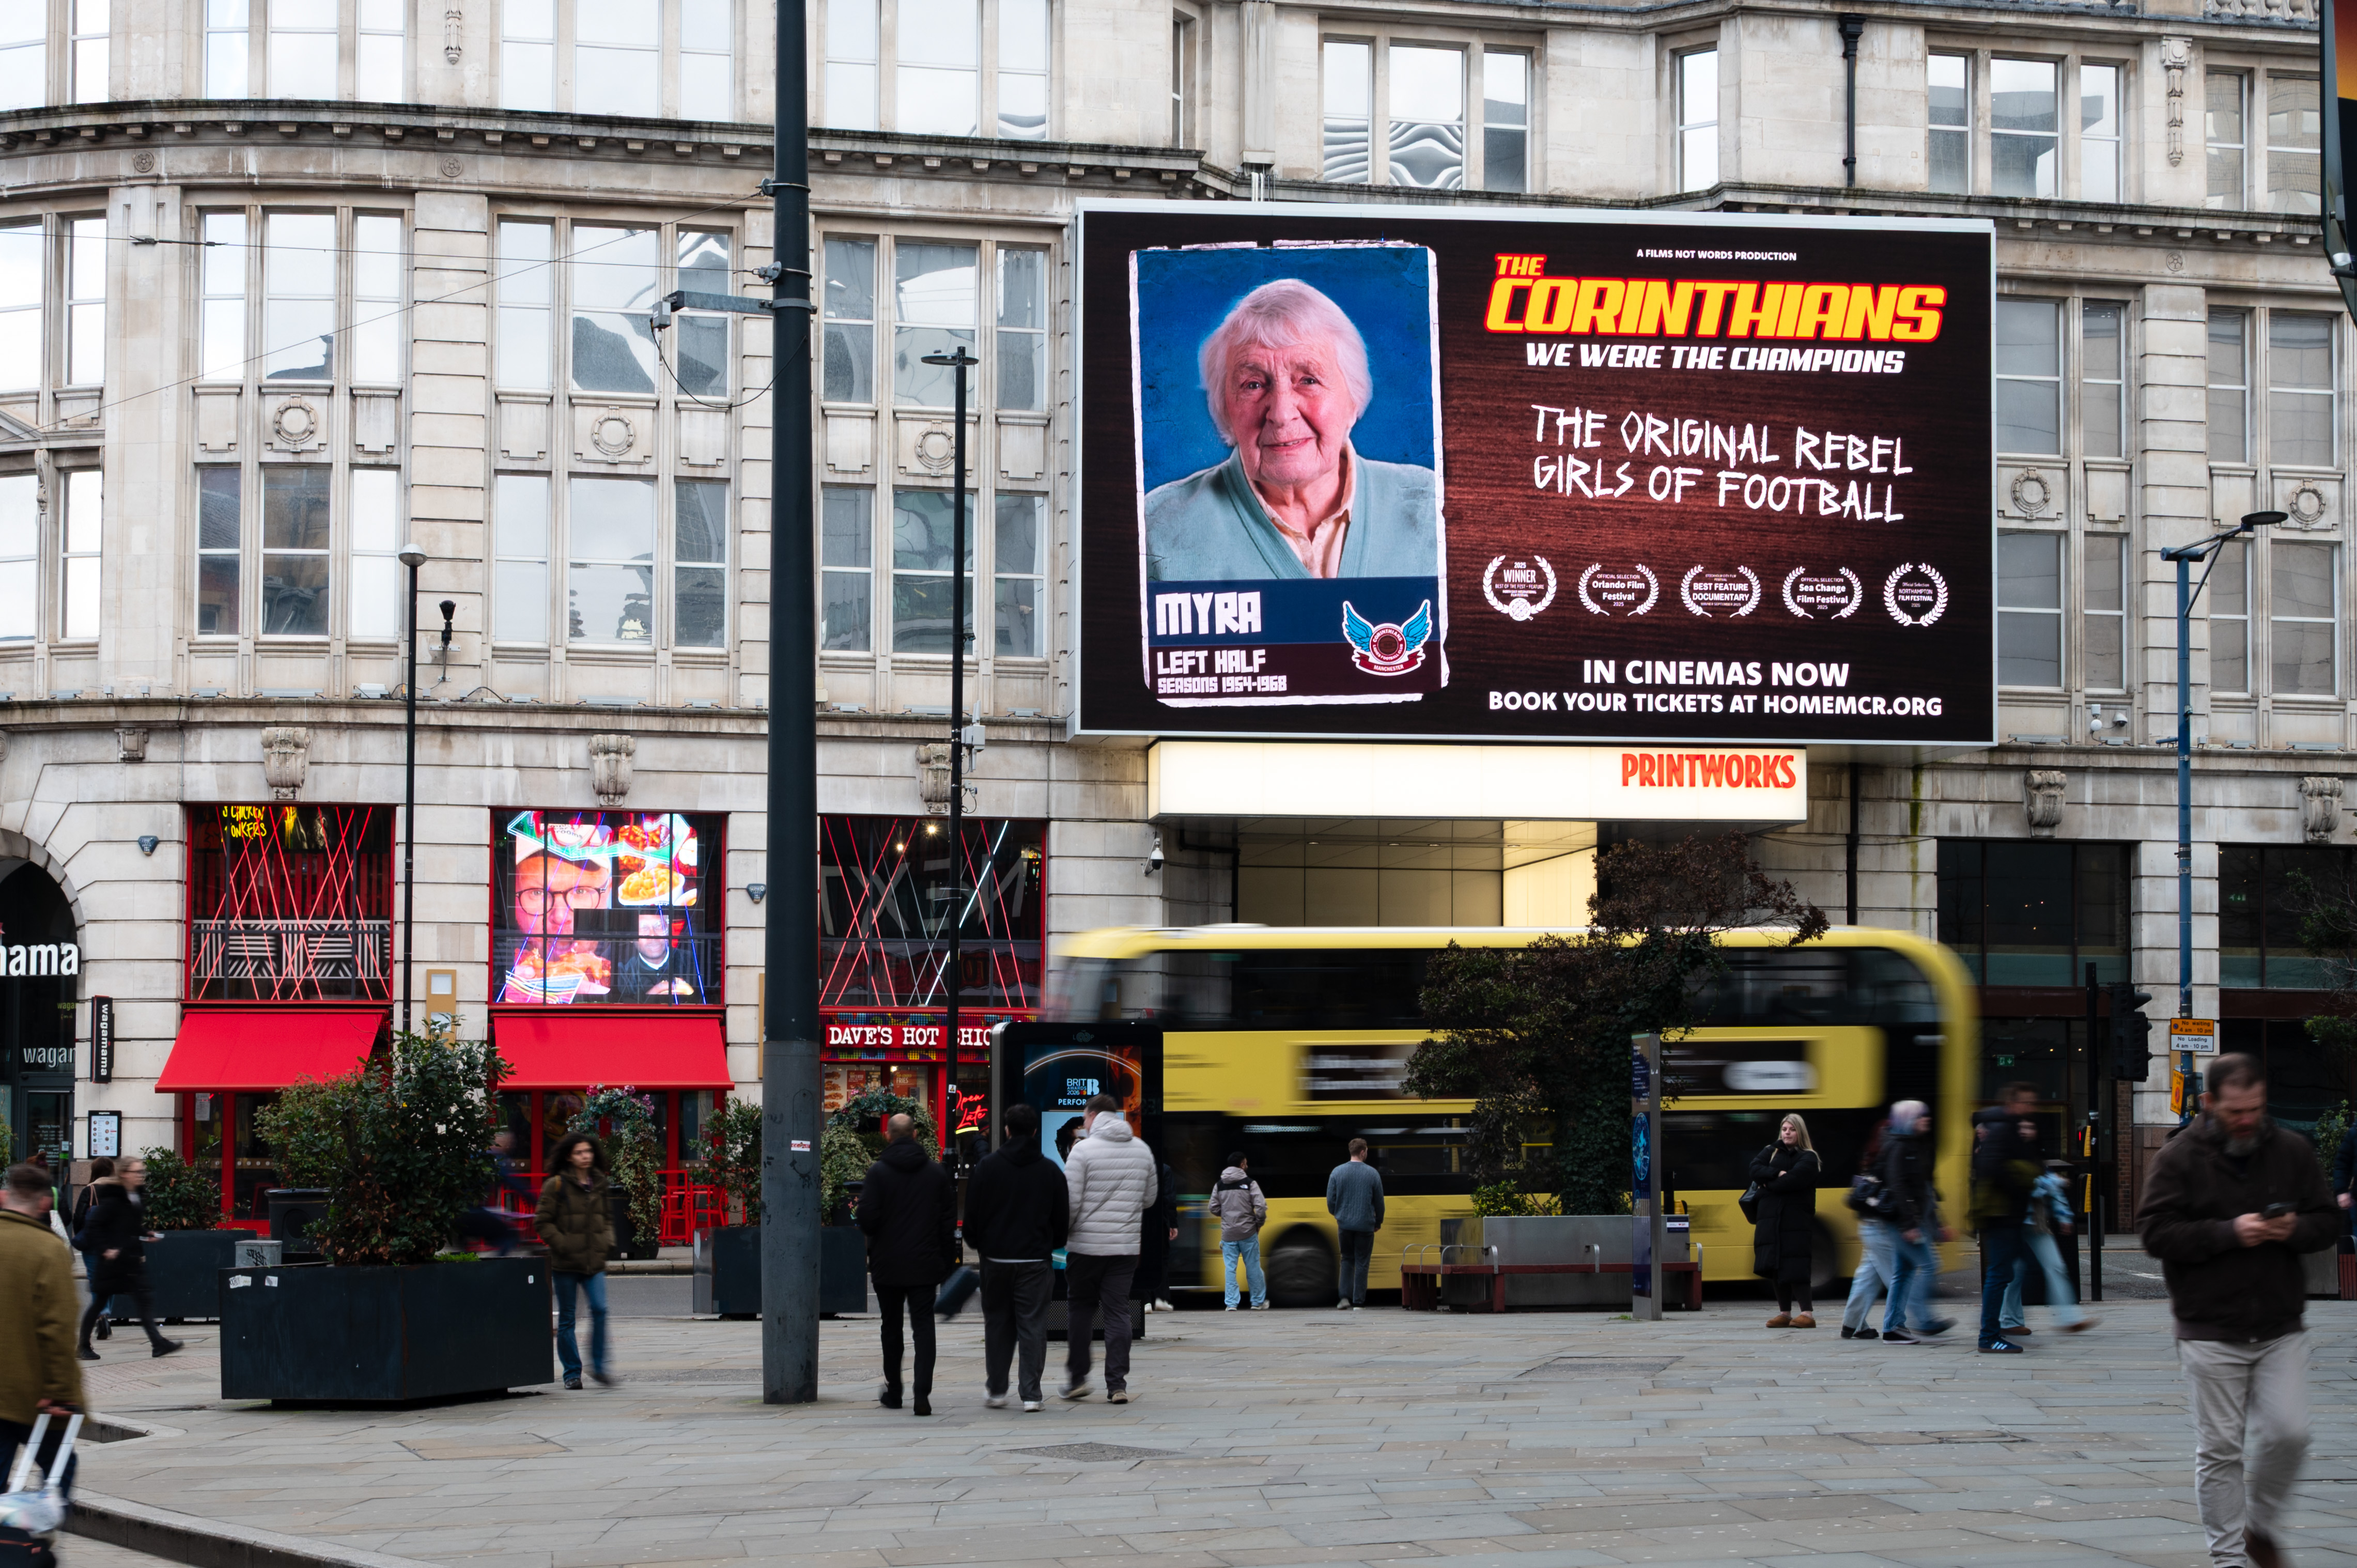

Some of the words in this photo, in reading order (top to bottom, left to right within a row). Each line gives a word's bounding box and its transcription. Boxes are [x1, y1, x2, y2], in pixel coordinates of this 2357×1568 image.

[1496, 255, 1545, 276] THE
[1637, 249, 1643, 257] A
[1646, 250, 1673, 258] FILMS
[1675, 250, 1696, 258] NOT
[1698, 251, 1733, 259] WORDS
[1735, 251, 1797, 260] PRODUCTION
[1485, 276, 1946, 341] CORINTHIANS
[1526, 343, 1574, 366] WE
[1580, 344, 1665, 368] WERE
[1670, 346, 1727, 369] THE
[1729, 347, 1905, 373] CHAMPIONS
[1531, 405, 1607, 448] THE
[1620, 411, 1779, 469] ORIGINAL
[1795, 426, 1913, 476] REBEL
[1534, 454, 1634, 499] GIRLS
[1648, 465, 1703, 503] OF
[1716, 470, 1904, 523] FOOTBALL
[1503, 569, 1536, 583] WINNER
[1592, 580, 1625, 588] Orlando
[1627, 581, 1645, 589] Film
[1602, 592, 1635, 600] Festival
[1816, 584, 1846, 594] Change
[1156, 592, 1261, 635] MYRA
[1373, 629, 1403, 643] CORINTHIANS
[1157, 650, 1208, 674] LEFT
[1215, 649, 1266, 673] HALF
[1372, 644, 1381, 658] LADIES
[1158, 677, 1218, 694] SEASONS
[1222, 675, 1287, 692] 1954-1968
[1584, 660, 1615, 683] IN
[1625, 660, 1762, 686] CINEMAS
[1772, 662, 1849, 687] NOW
[1490, 691, 1557, 710] BOOK
[1563, 692, 1626, 711] YOUR
[1633, 693, 1723, 712] TICKETS
[1729, 695, 1757, 713] AT
[1764, 695, 1942, 716] HOMEMCR.ORG
[1622, 753, 1796, 788] PRINTWORKS
[225, 821, 267, 840] ONKERS
[100, 1004, 108, 1076] wagamama
[829, 1026, 892, 1045] DAVE'S
[903, 1028, 939, 1045] HOT
[957, 1105, 988, 1129] Late
